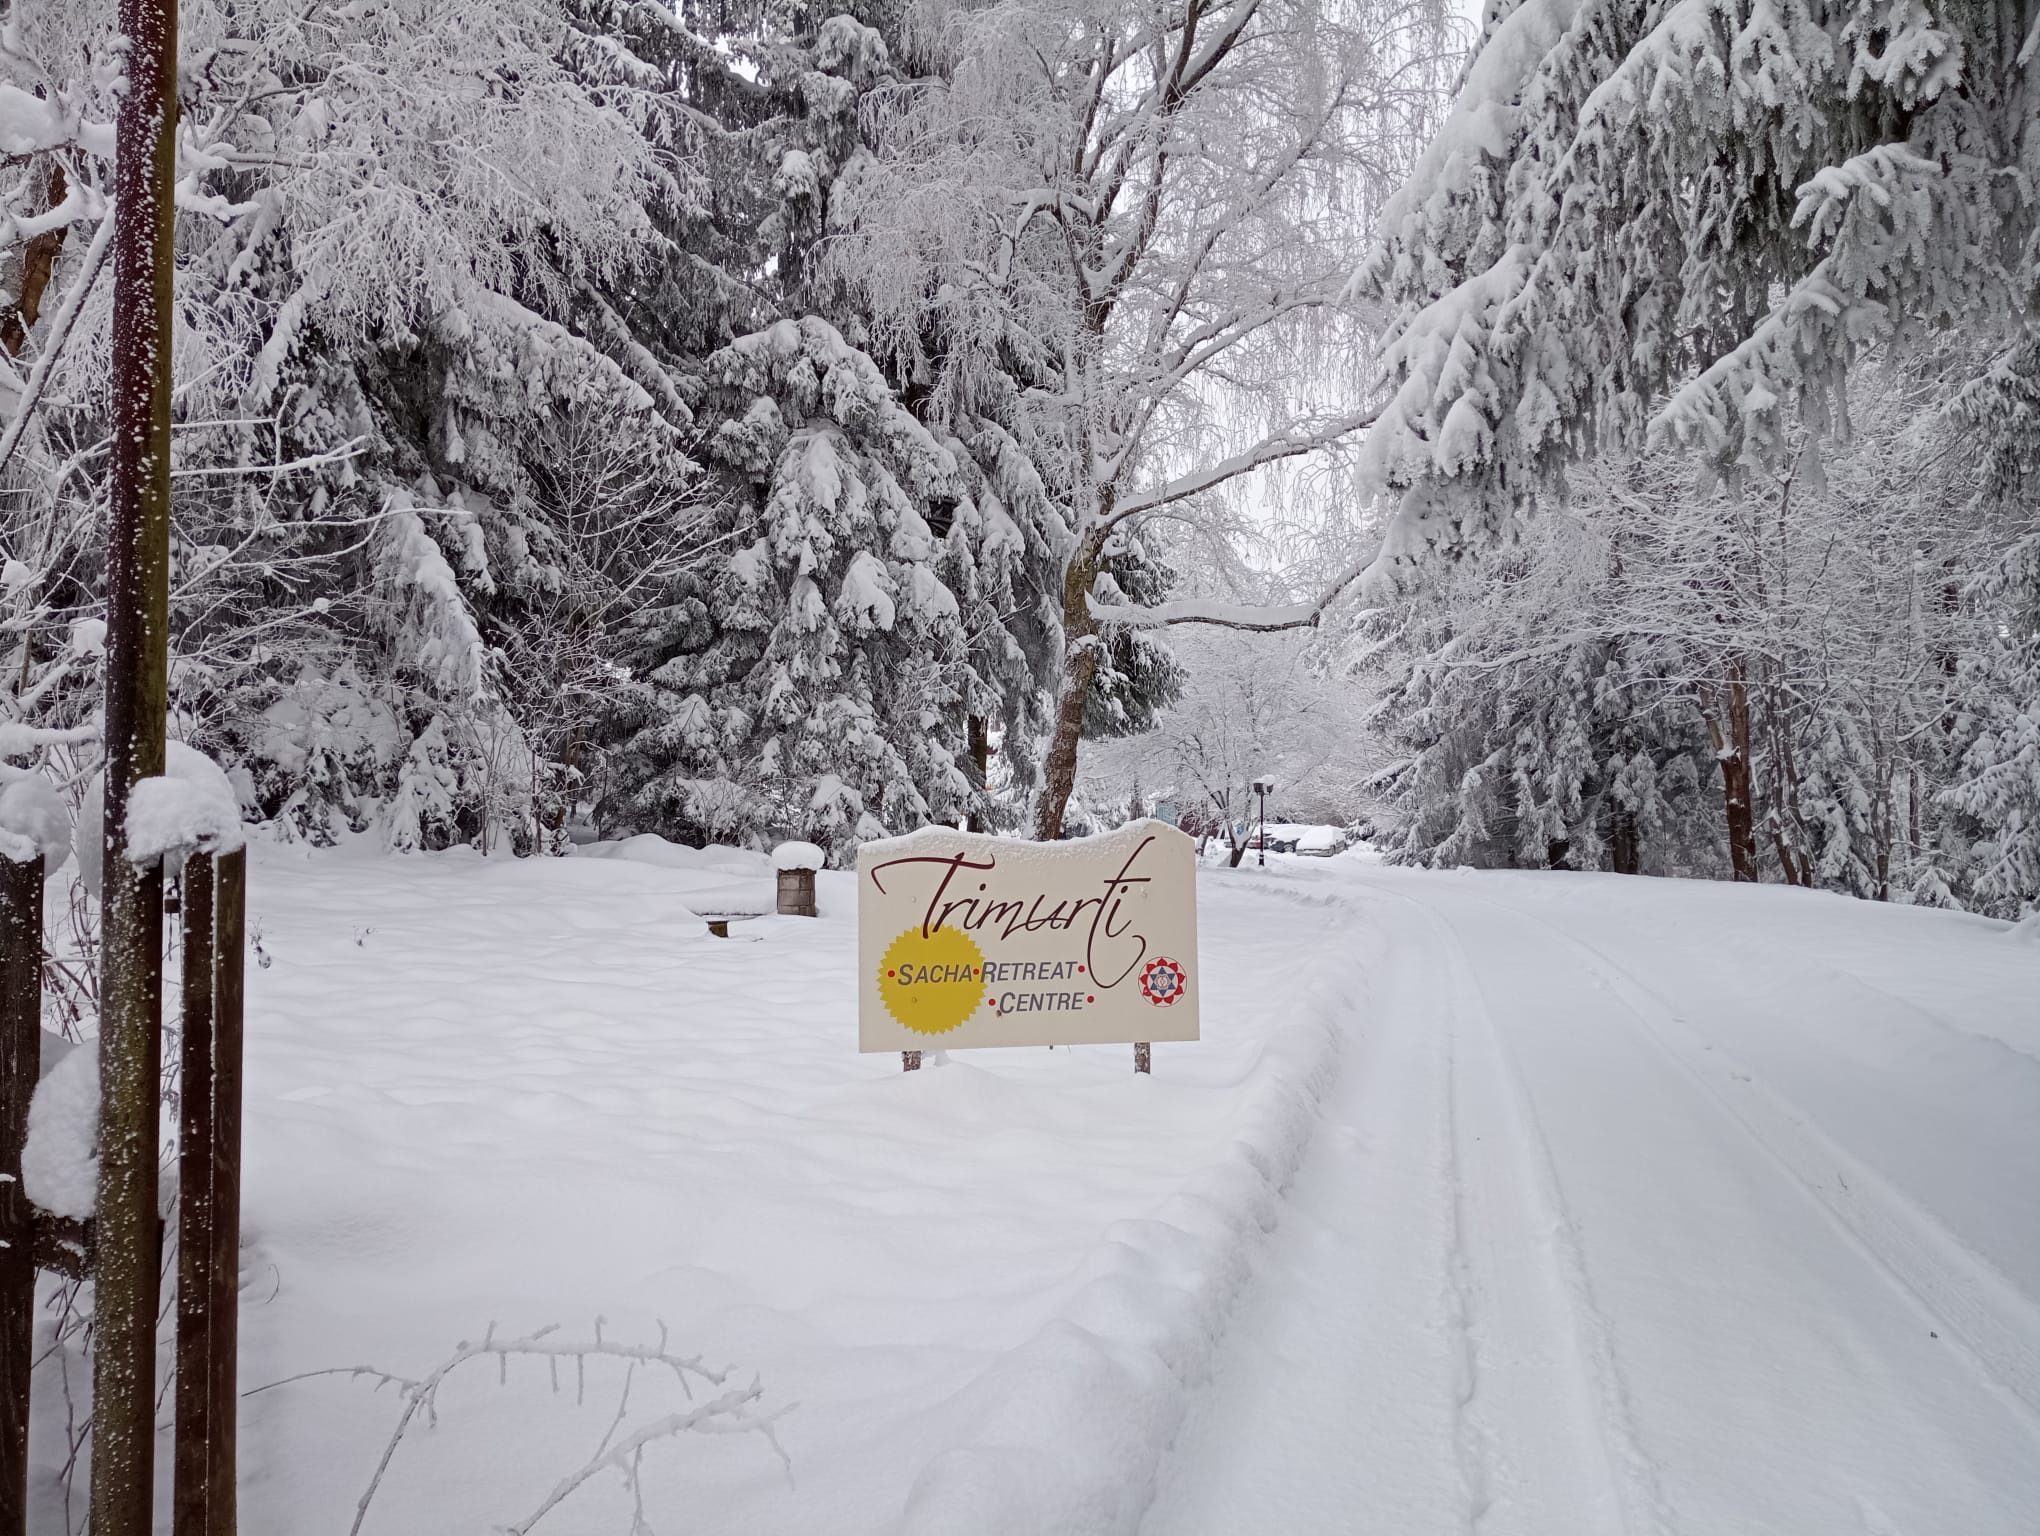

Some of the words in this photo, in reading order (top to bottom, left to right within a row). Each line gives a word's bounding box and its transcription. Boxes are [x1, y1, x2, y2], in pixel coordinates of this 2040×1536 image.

[871, 836, 1155, 989] Trimurti
[897, 963, 973, 985] SACHA
[980, 960, 1078, 983] RETREAT
[999, 991, 1085, 1014] CENTRE
